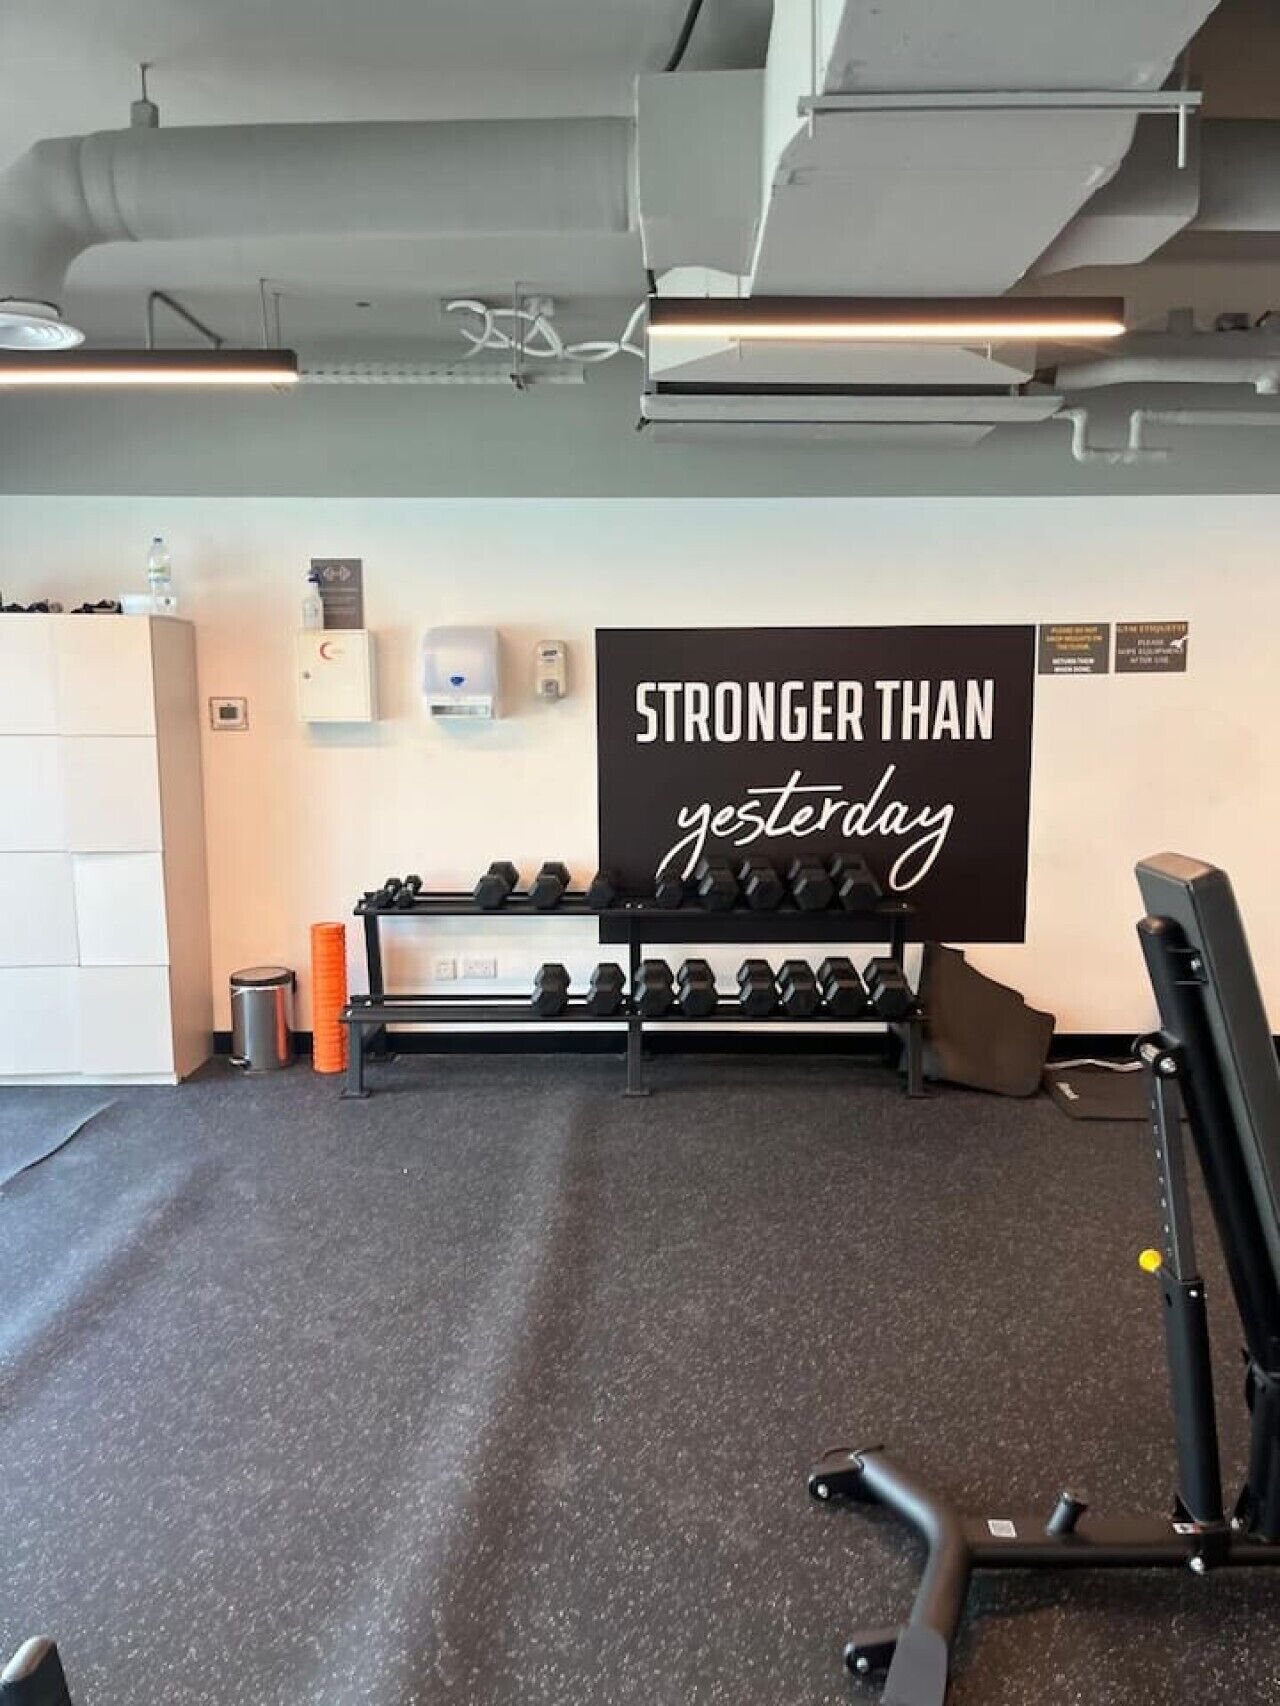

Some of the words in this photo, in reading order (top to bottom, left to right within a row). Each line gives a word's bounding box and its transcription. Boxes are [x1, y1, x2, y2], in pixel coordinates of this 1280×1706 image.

[636, 681, 864, 743] STRONGER
[874, 679, 995, 741] THAN
[656, 764, 954, 891] yesterday
